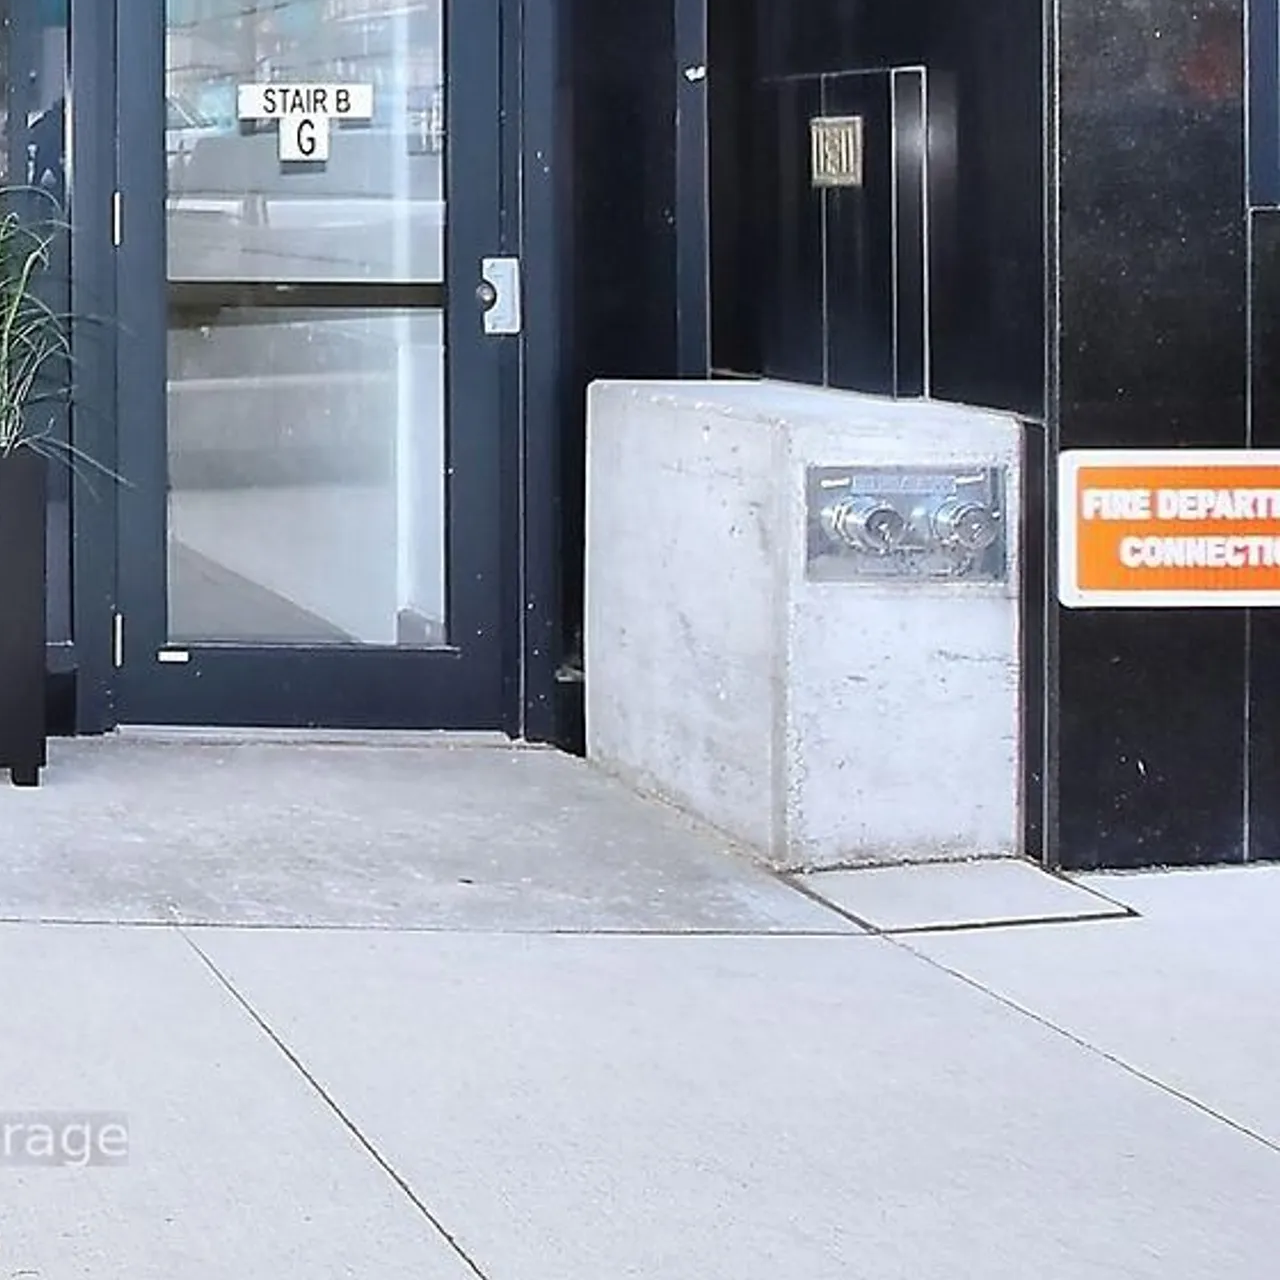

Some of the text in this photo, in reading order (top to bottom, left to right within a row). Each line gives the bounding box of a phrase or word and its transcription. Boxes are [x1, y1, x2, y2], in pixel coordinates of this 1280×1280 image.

[263, 89, 351, 114] STAIR B
[297, 119, 316, 156] G
[1081, 487, 1280, 520] FIRE DEPART
